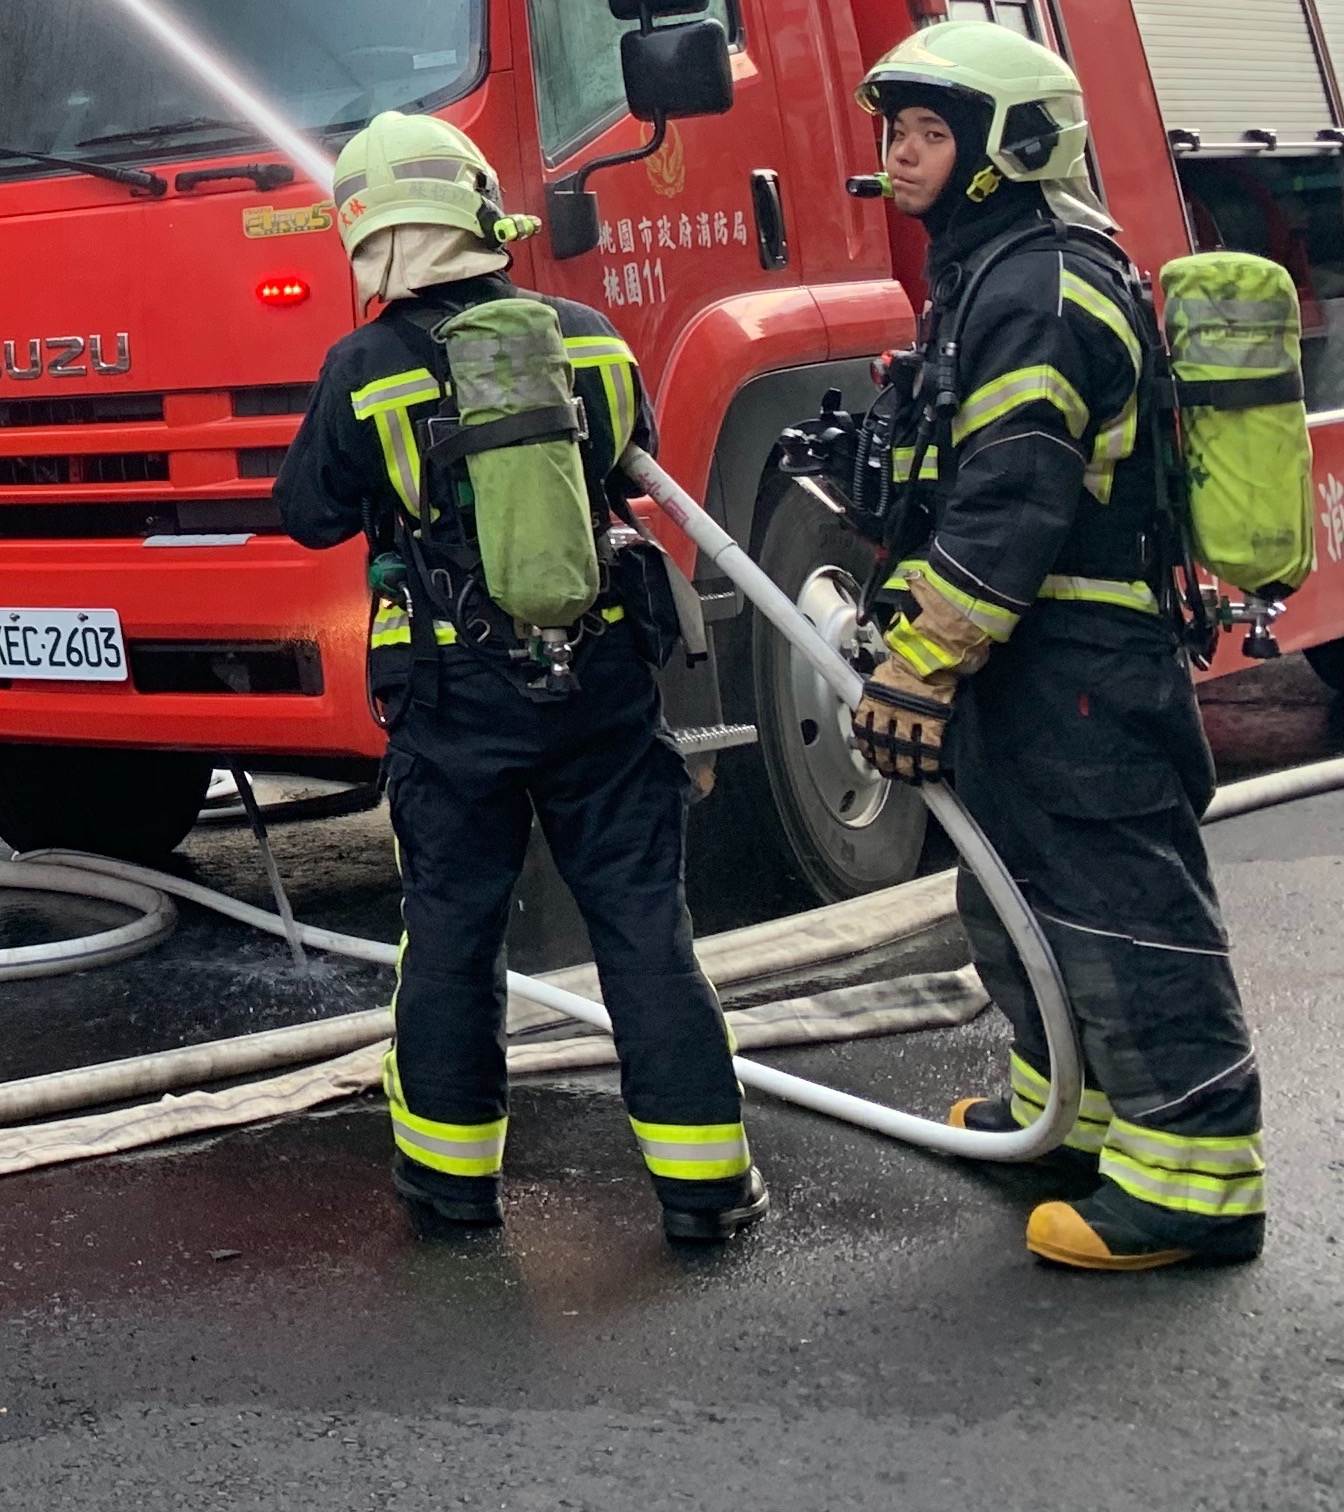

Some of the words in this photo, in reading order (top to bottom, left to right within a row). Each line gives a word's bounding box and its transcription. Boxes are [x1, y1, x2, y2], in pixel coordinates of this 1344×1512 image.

[597, 210, 748, 255] 桃園市政府消防局
[602, 256, 667, 309] 桃園11
